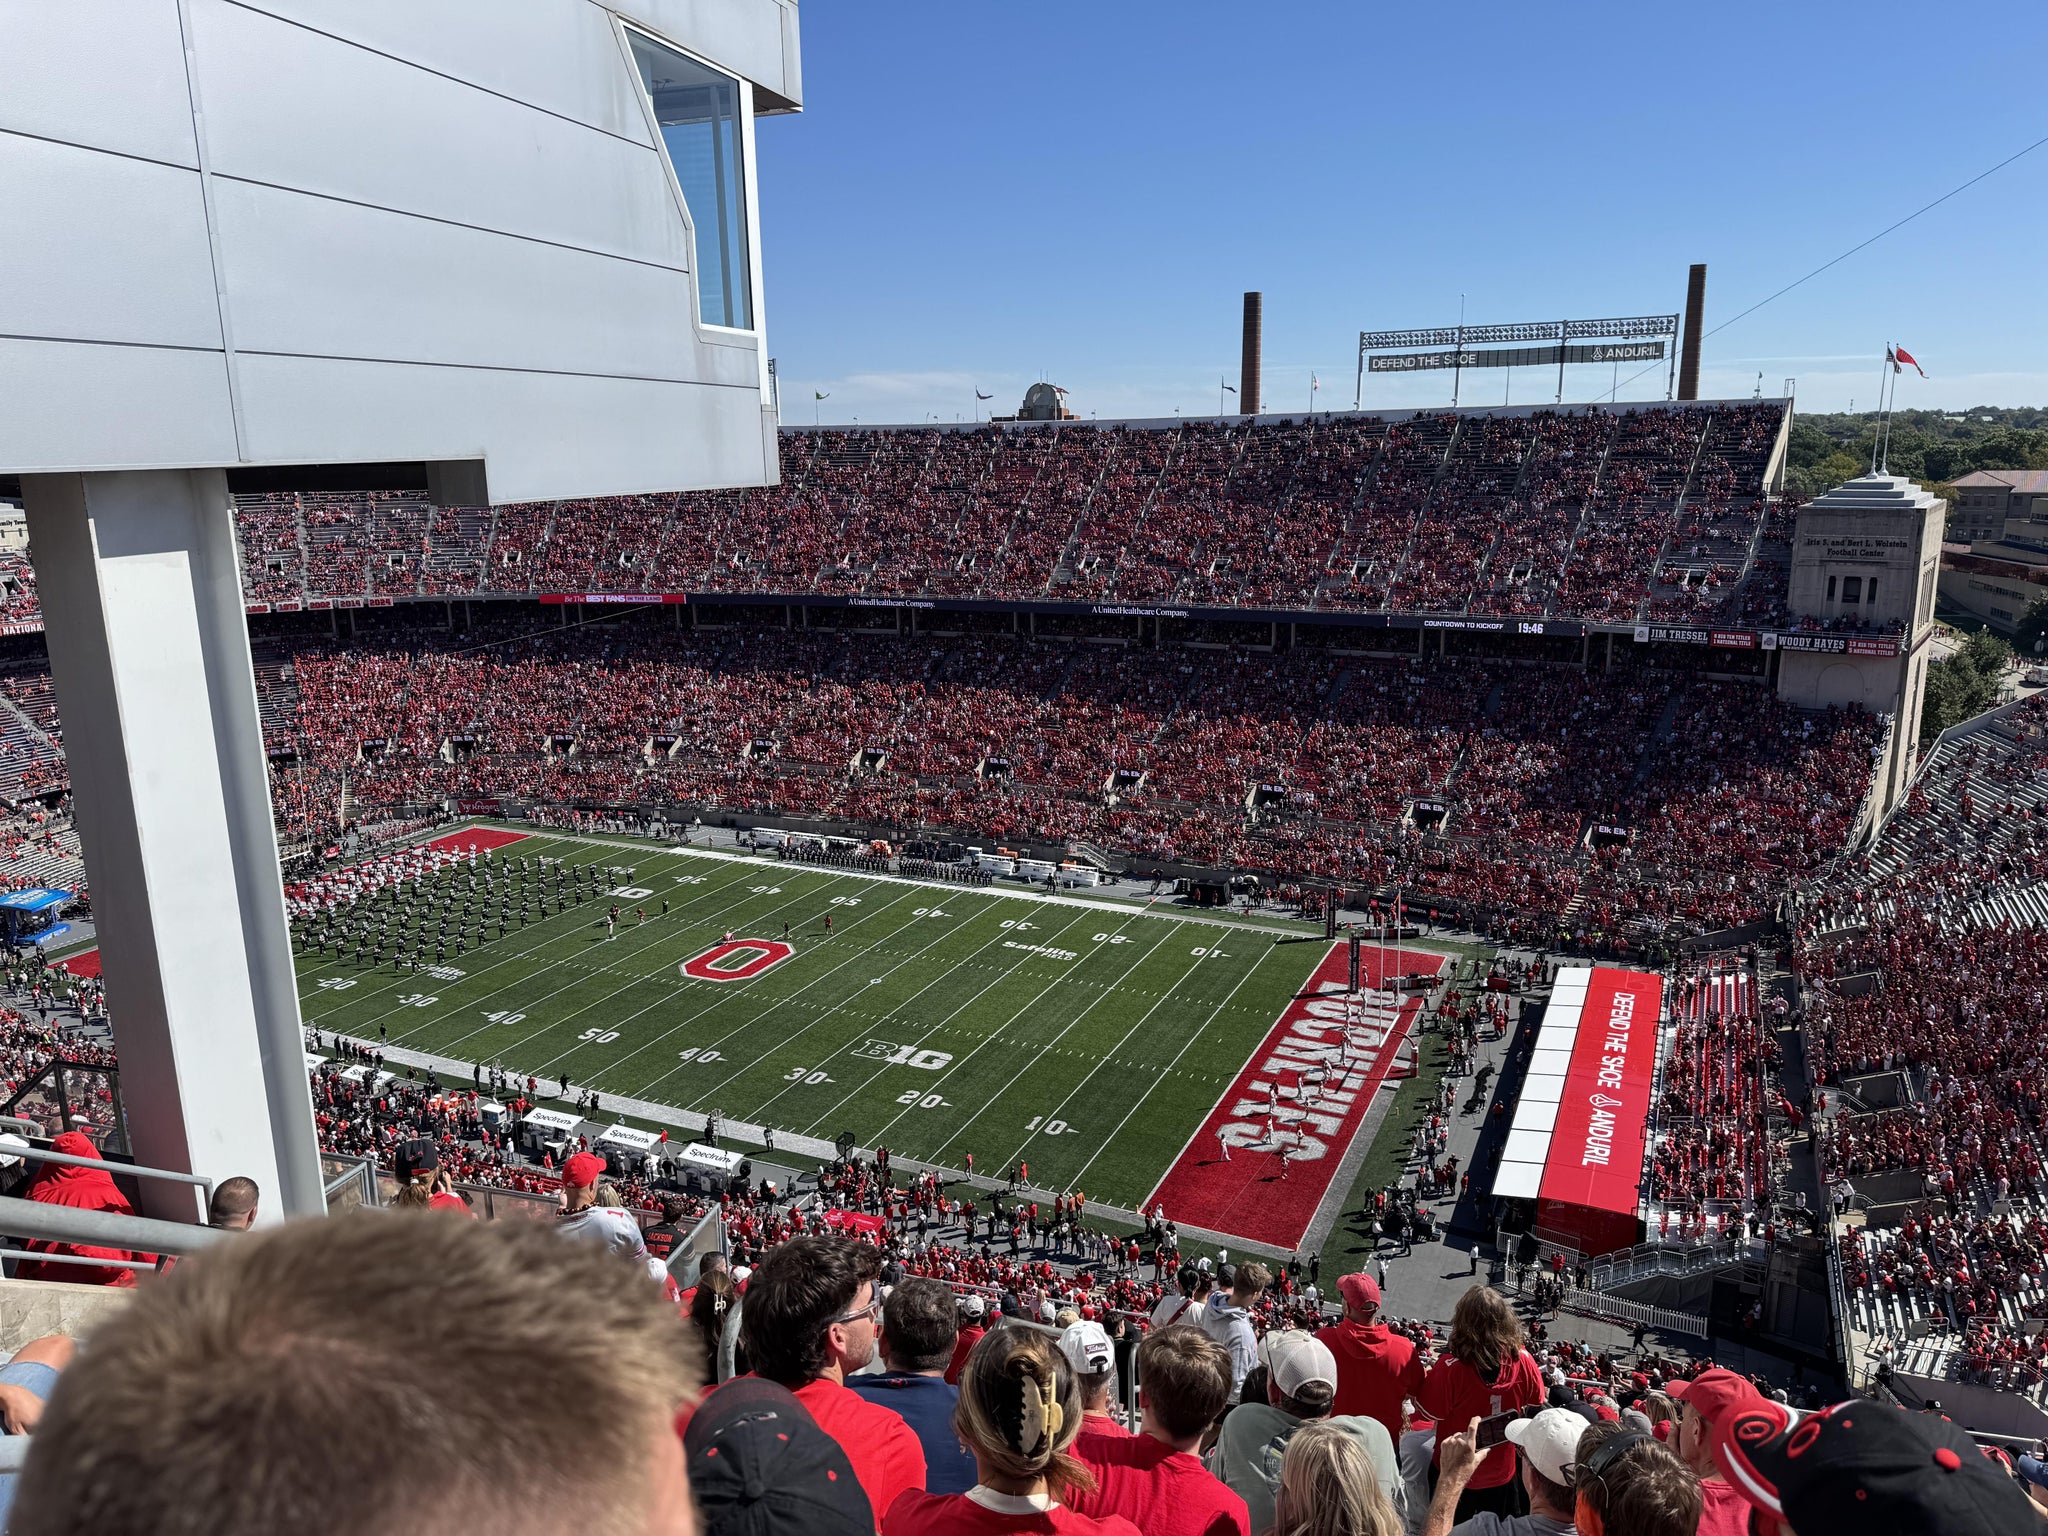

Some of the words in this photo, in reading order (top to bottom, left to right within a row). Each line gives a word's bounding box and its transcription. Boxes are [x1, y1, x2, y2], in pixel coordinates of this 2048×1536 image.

[1605, 346, 1659, 358] ANDURIL
[1372, 357, 1415, 368] DEFEND
[1417, 355, 1439, 366] THE
[1807, 538, 1820, 546] Iris
[1847, 539, 1863, 547] Bert
[1875, 540, 1908, 548] Wolstein
[1827, 548, 1857, 557] Football
[1859, 549, 1885, 557] Center
[310, 601, 331, 610] 2002
[340, 600, 361, 608] 2014
[370, 598, 391, 606] 2024
[854, 598, 905, 607] UnitedHealthcare
[1098, 606, 1155, 616] UnitedHealthcare
[1424, 620, 1465, 628] COUNTDOWN
[1476, 622, 1503, 630] KICKOFF
[1518, 622, 1543, 634] 19:46
[1650, 629, 1667, 638] JIM
[1669, 630, 1708, 641] TRESSEL
[1778, 636, 1811, 647] WOODY
[1814, 638, 1845, 650] HAYES
[1262, 784, 1273, 792] Elk
[1273, 785, 1285, 793] Elk
[1420, 802, 1431, 811] Elk
[1432, 803, 1445, 812] Elk
[1598, 825, 1612, 834] Elk
[1613, 827, 1627, 836] Elk
[751, 885, 782, 895] 40
[830, 896, 862, 906] 50
[911, 907, 944, 918] 40
[1408, 906, 1427, 915] TOYOTA
[1000, 919, 1033, 930] 30
[1092, 933, 1126, 944] 20
[1002, 941, 1078, 957] Safelite
[1190, 947, 1222, 958] 10
[1041, 952, 1074, 962] FIELD
[321, 977, 358, 990] 20
[401, 994, 439, 1007] 30
[1609, 992, 1635, 1031] DEFEND
[485, 1011, 526, 1025] 40
[578, 1028, 620, 1043] 50
[1604, 1032, 1629, 1054] THE
[678, 1047, 721, 1063] 40
[784, 1068, 828, 1085] 30
[896, 1090, 943, 1108] 20
[532, 1112, 570, 1126] Spectrum
[1024, 1116, 1068, 1135] 10
[609, 1129, 648, 1143] Spectrum
[1582, 1108, 1616, 1166] ANDURIL
[689, 1148, 730, 1163] Spectrum
[646, 1232, 673, 1243] JACKSON
